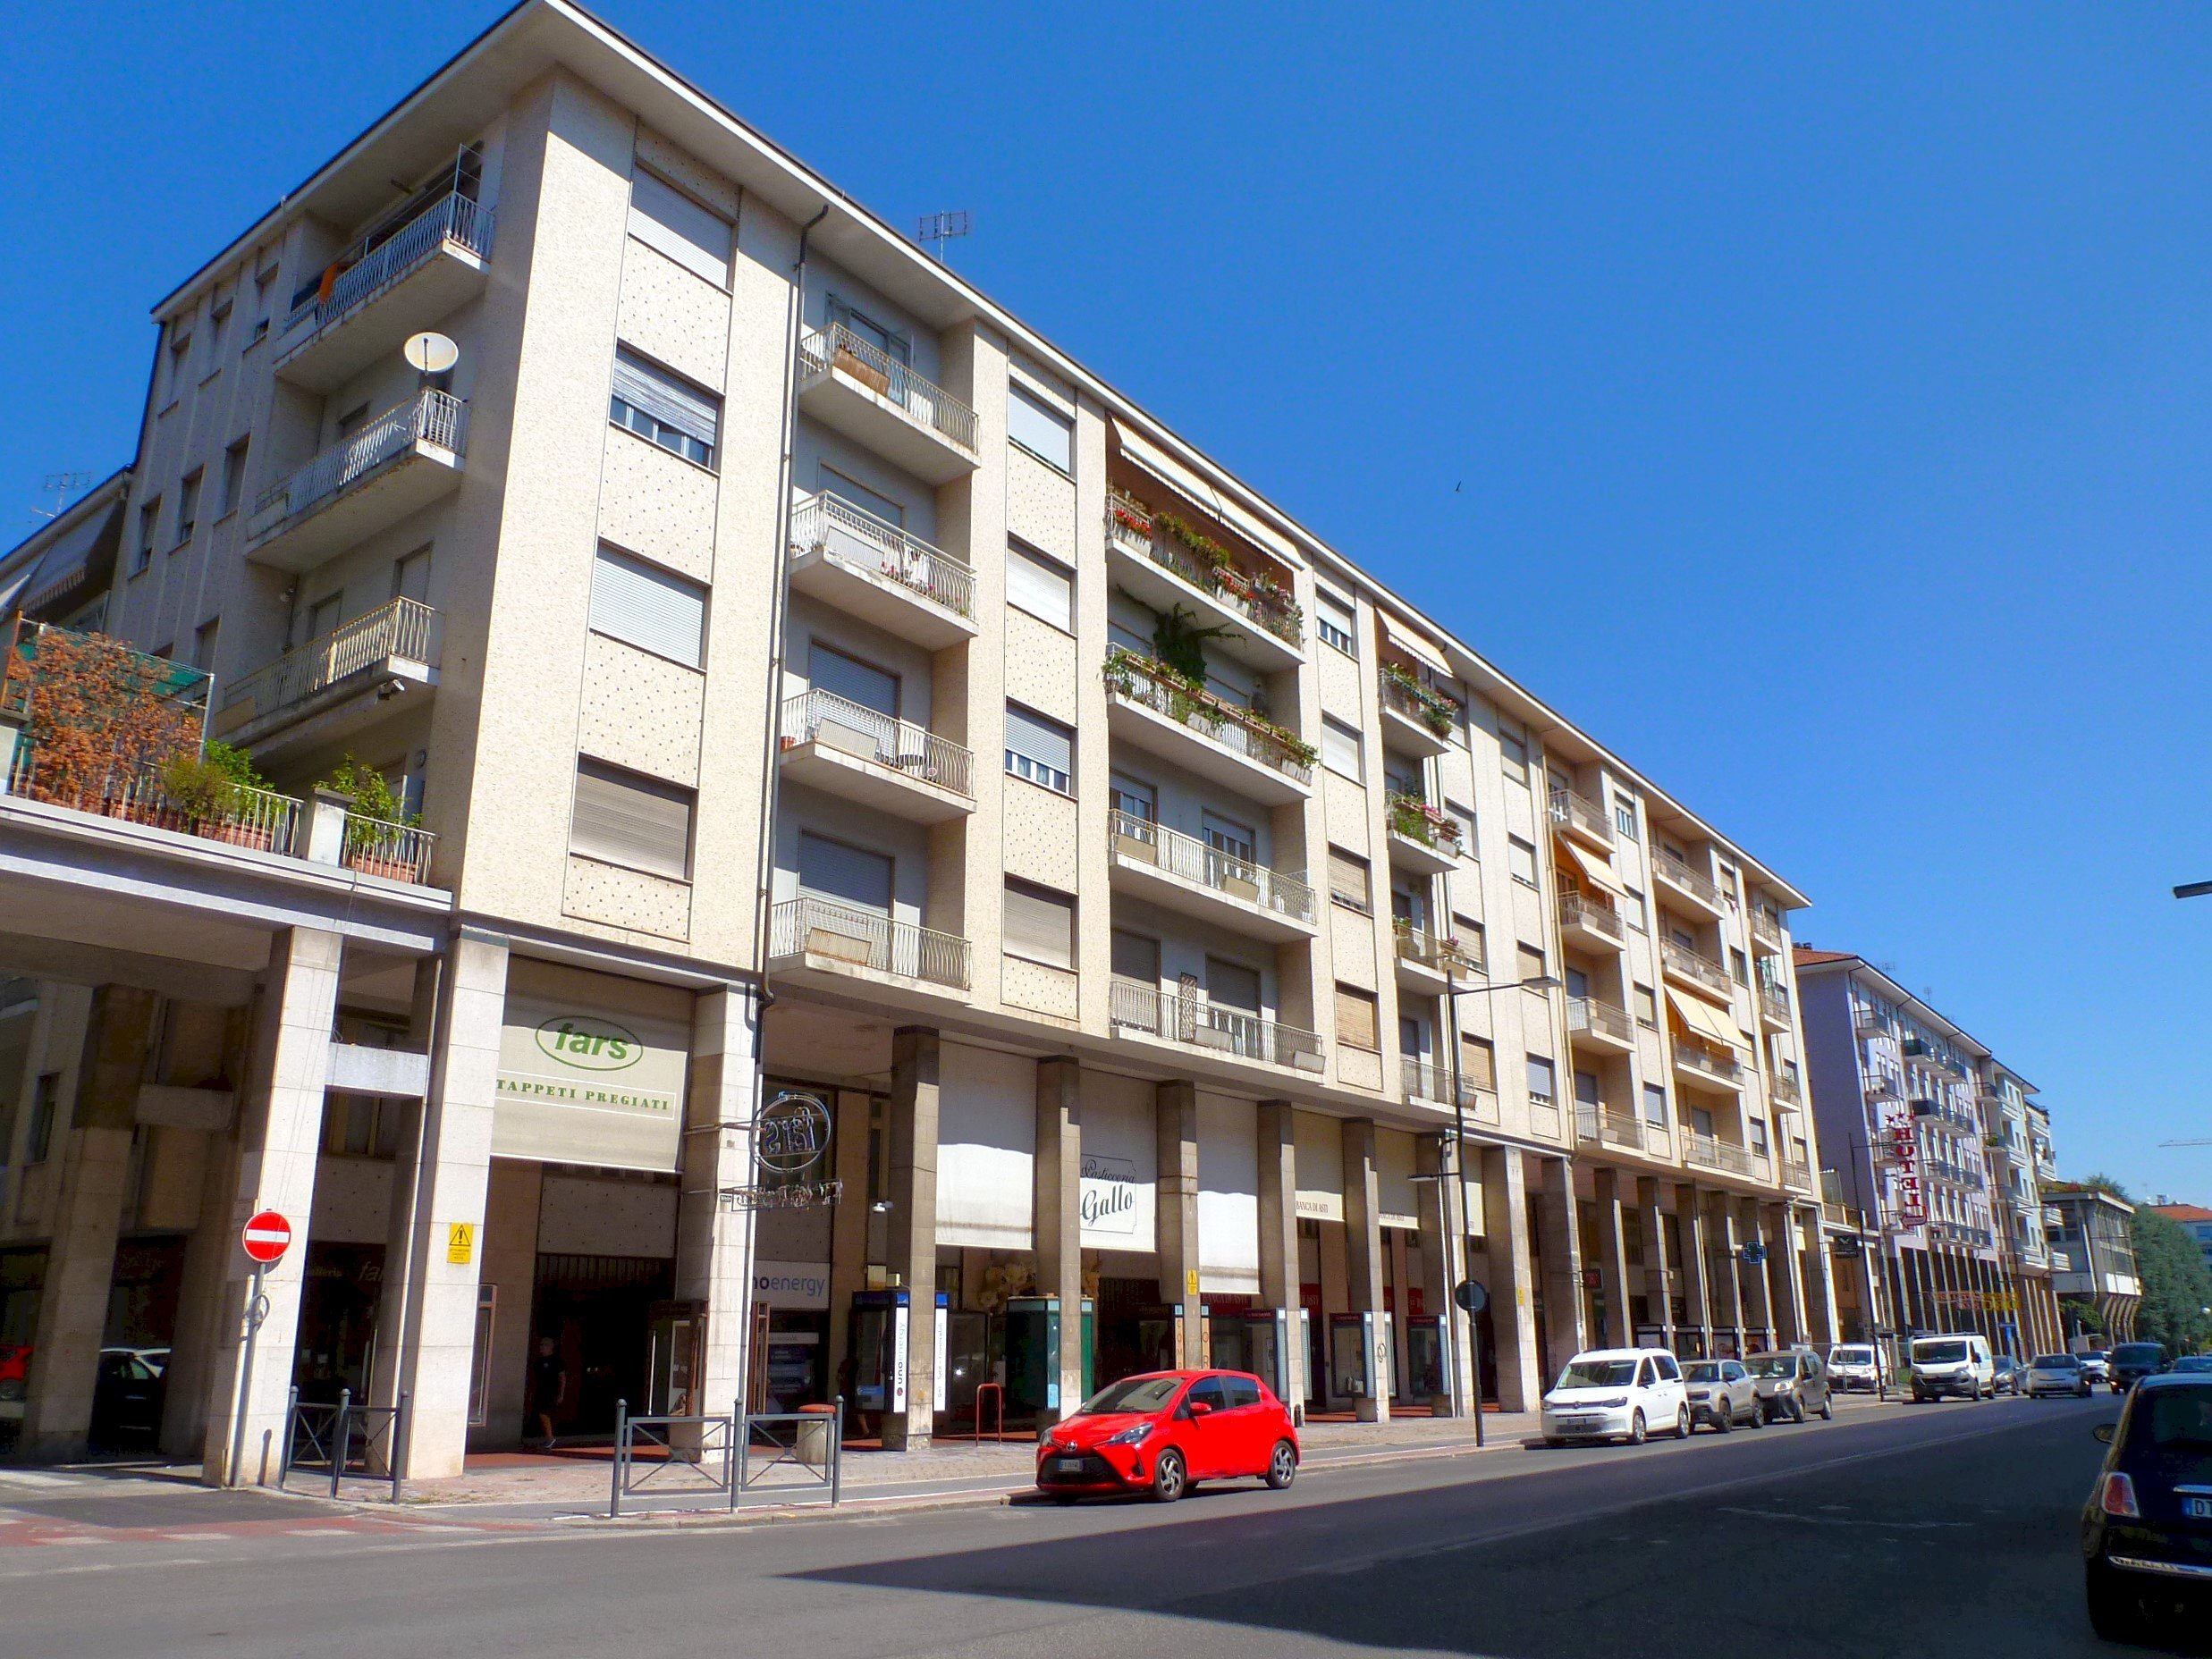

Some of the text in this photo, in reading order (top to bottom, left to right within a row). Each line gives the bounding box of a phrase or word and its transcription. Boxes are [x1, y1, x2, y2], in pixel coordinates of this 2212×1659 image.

[554, 1023, 629, 1061] fars
[496, 1078, 669, 1111] TAPPETI PREGIATI
[1080, 1158, 1136, 1184] Pasticceria
[1080, 1183, 1135, 1227] Gallo
[898, 1322, 907, 1385] unoenergy
